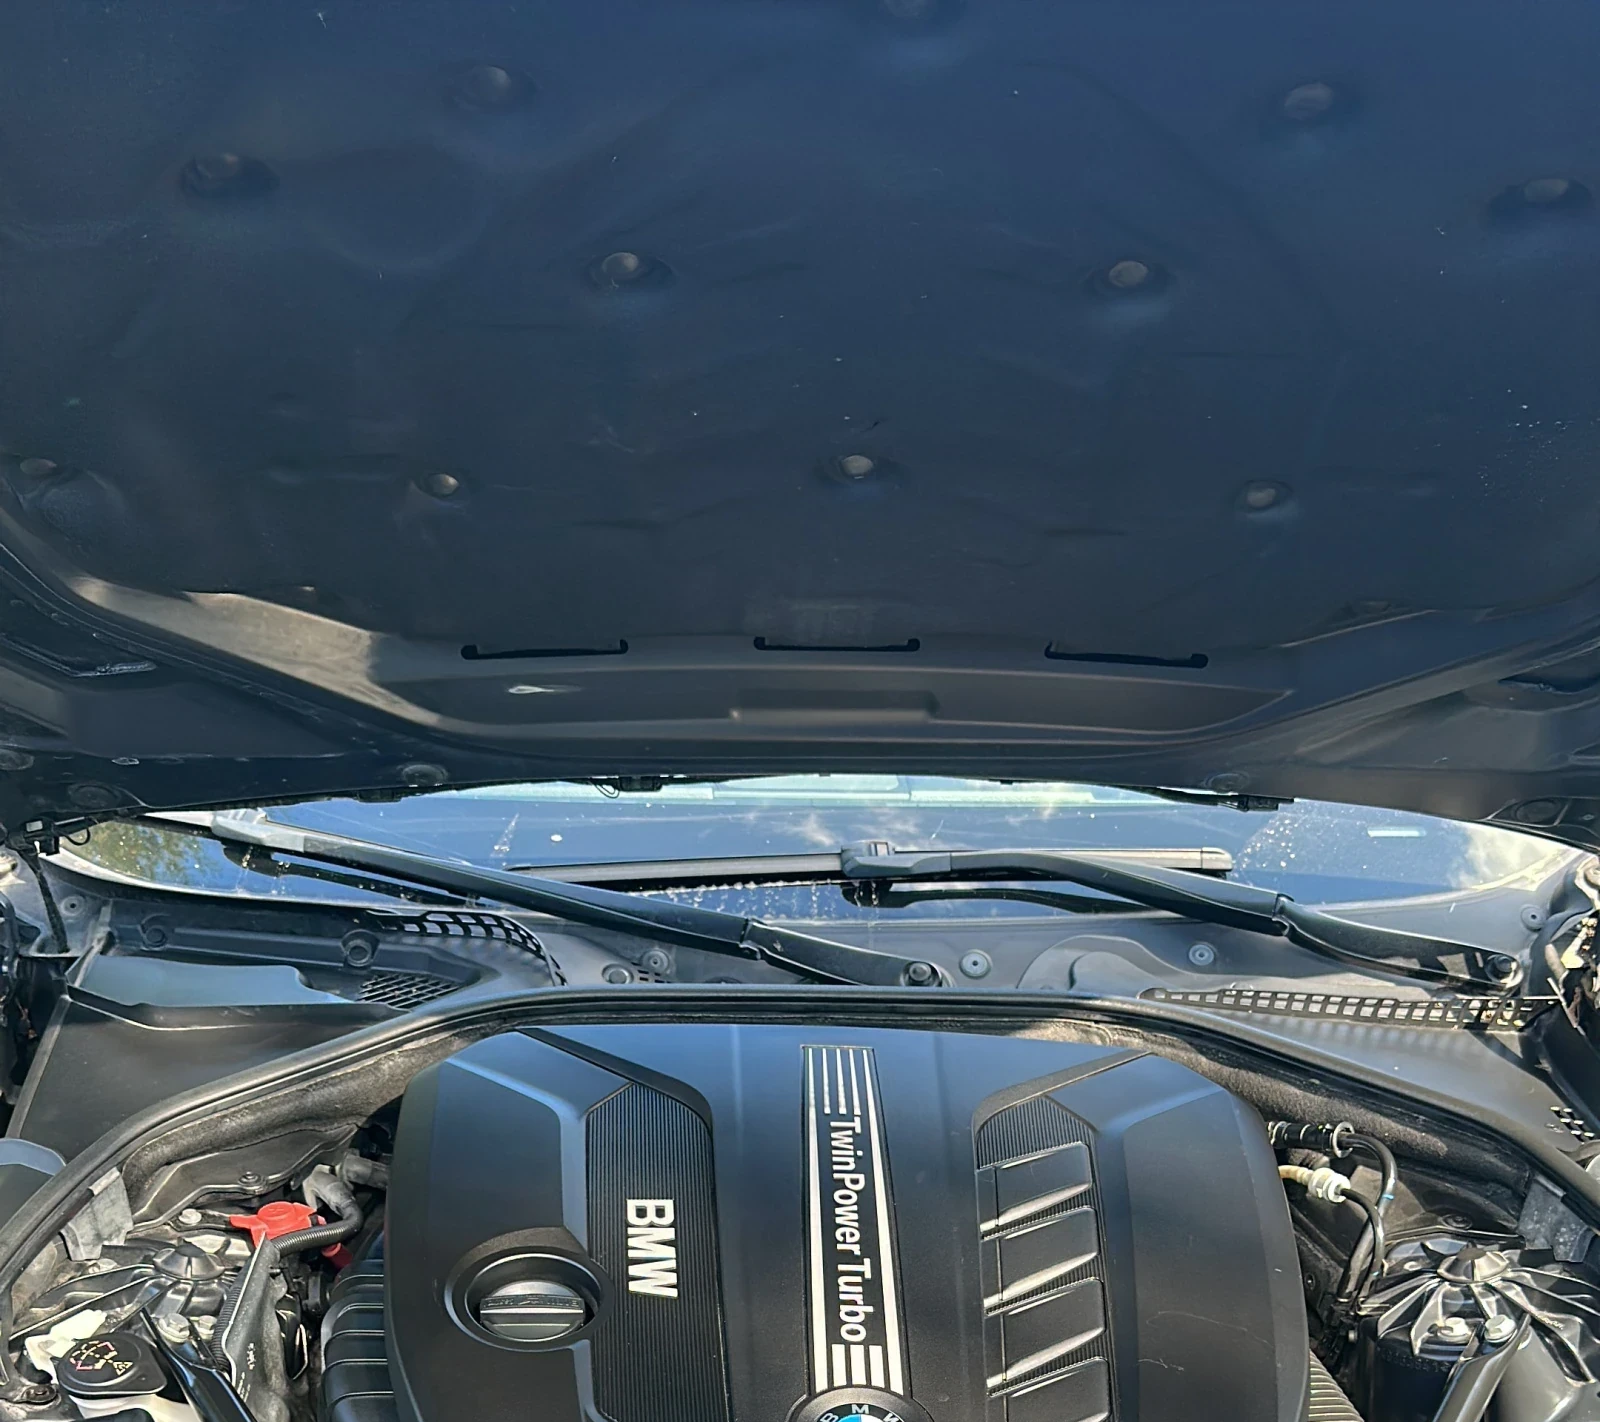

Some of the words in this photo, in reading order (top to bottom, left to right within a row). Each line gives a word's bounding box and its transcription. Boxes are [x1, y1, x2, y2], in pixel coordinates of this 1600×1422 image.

[829, 1116, 866, 1256] TwinPower
[626, 1198, 678, 1298] BMW
[837, 1257, 874, 1342] Turbo
